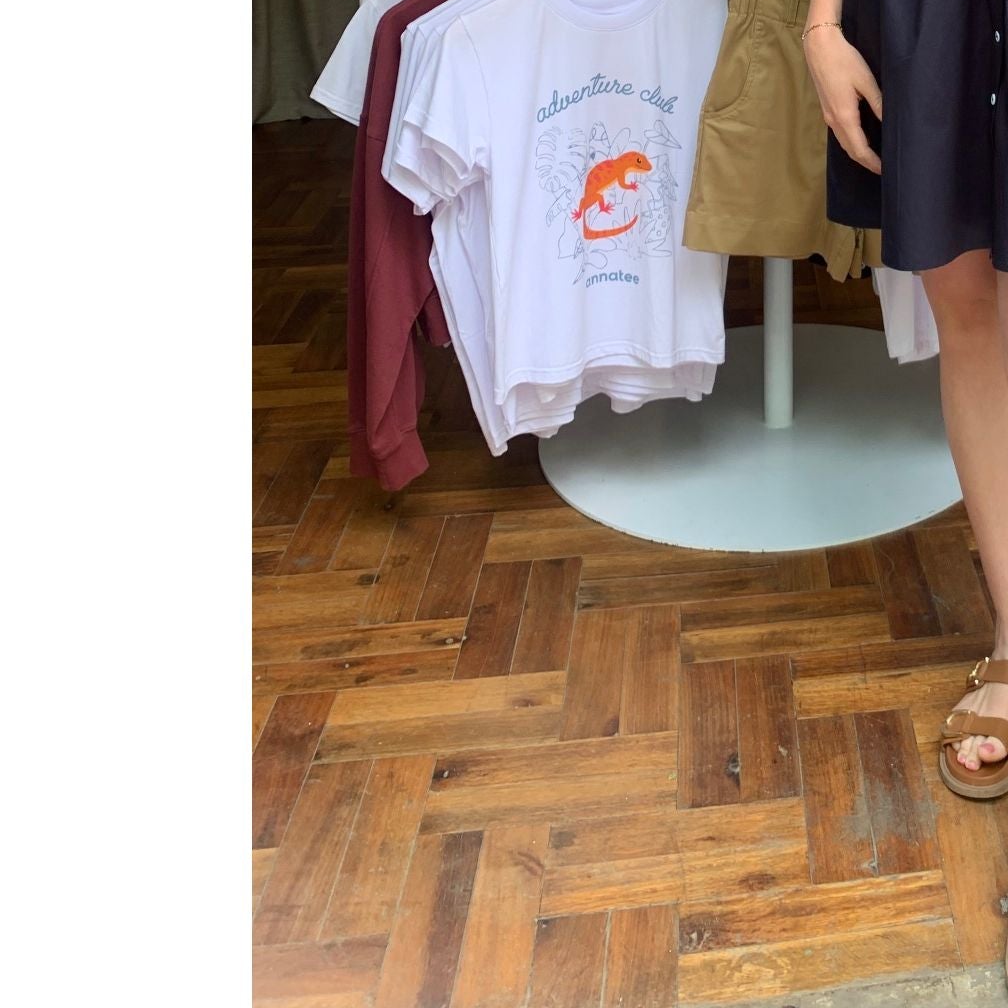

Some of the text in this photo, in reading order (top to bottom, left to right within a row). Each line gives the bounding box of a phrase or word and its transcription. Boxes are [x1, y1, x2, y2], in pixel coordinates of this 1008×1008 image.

[537, 72, 678, 123] adventure club
[585, 269, 639, 288] annatee
